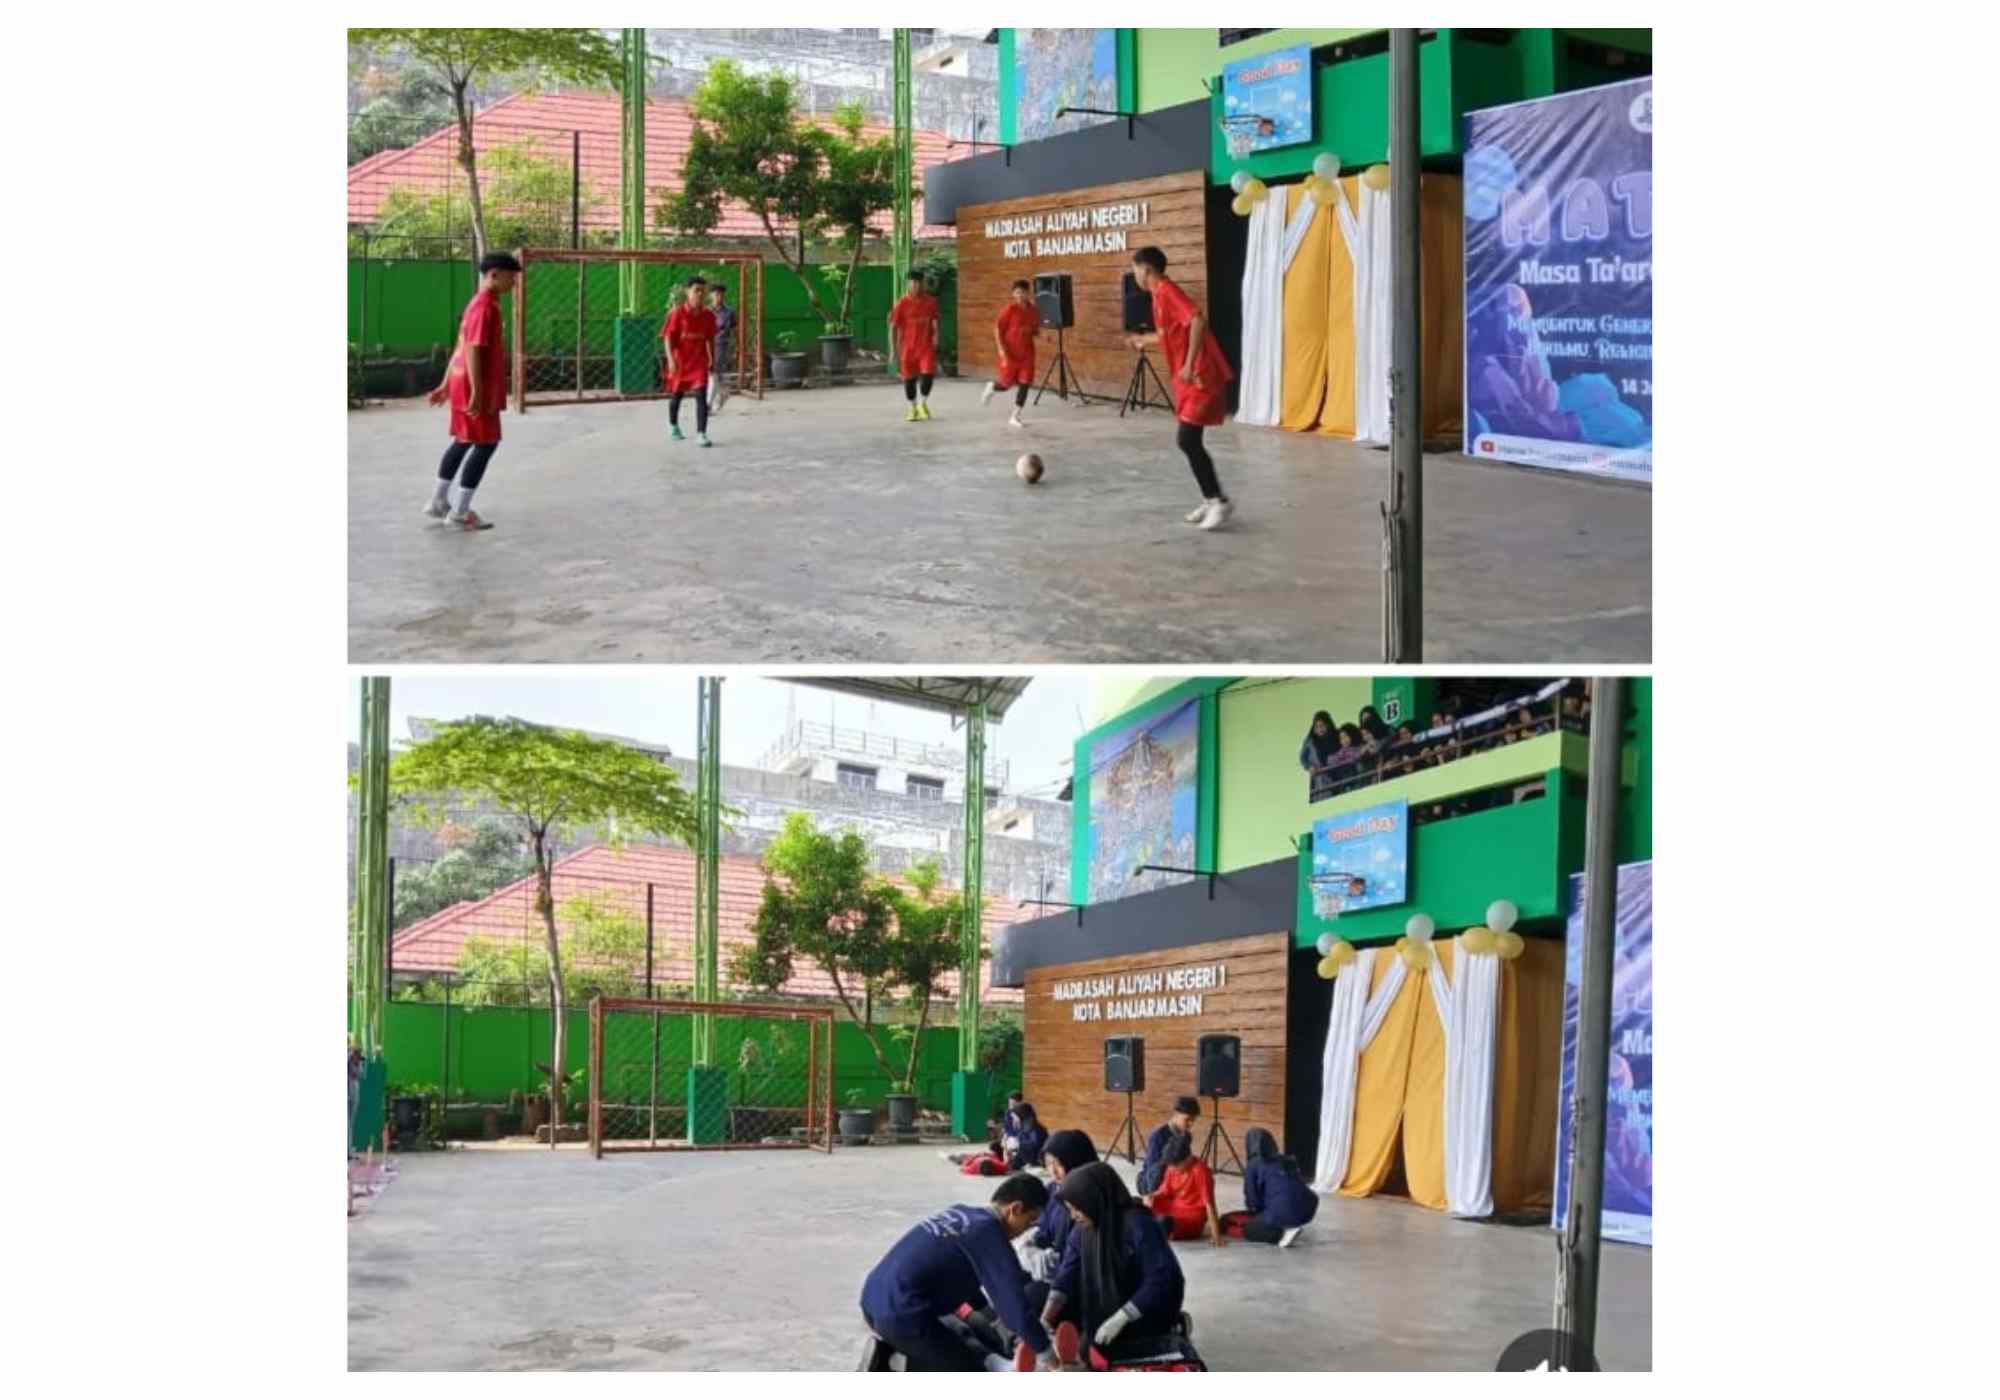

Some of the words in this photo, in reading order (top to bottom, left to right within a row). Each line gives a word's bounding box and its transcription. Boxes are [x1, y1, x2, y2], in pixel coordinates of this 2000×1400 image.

[985, 215, 1043, 238] MADRASAH
[1047, 208, 1088, 232] ALIYAH
[1092, 203, 1138, 228] NEGERI
[1142, 202, 1148, 225] 1
[1004, 239, 1031, 258] KOTA
[1036, 231, 1127, 256] BANJARMASIN
[1519, 259, 1580, 285] Masa
[1585, 255, 1652, 283] Ta'ar
[1621, 378, 1638, 395] 14
[1054, 976, 1114, 1000] MADRASAH
[1118, 972, 1162, 995] ALIYAH
[1167, 966, 1216, 990] NEGERI
[1220, 964, 1226, 987] 1
[1073, 1002, 1101, 1022] KOTA
[1107, 994, 1202, 1020] BANJARMASIN
